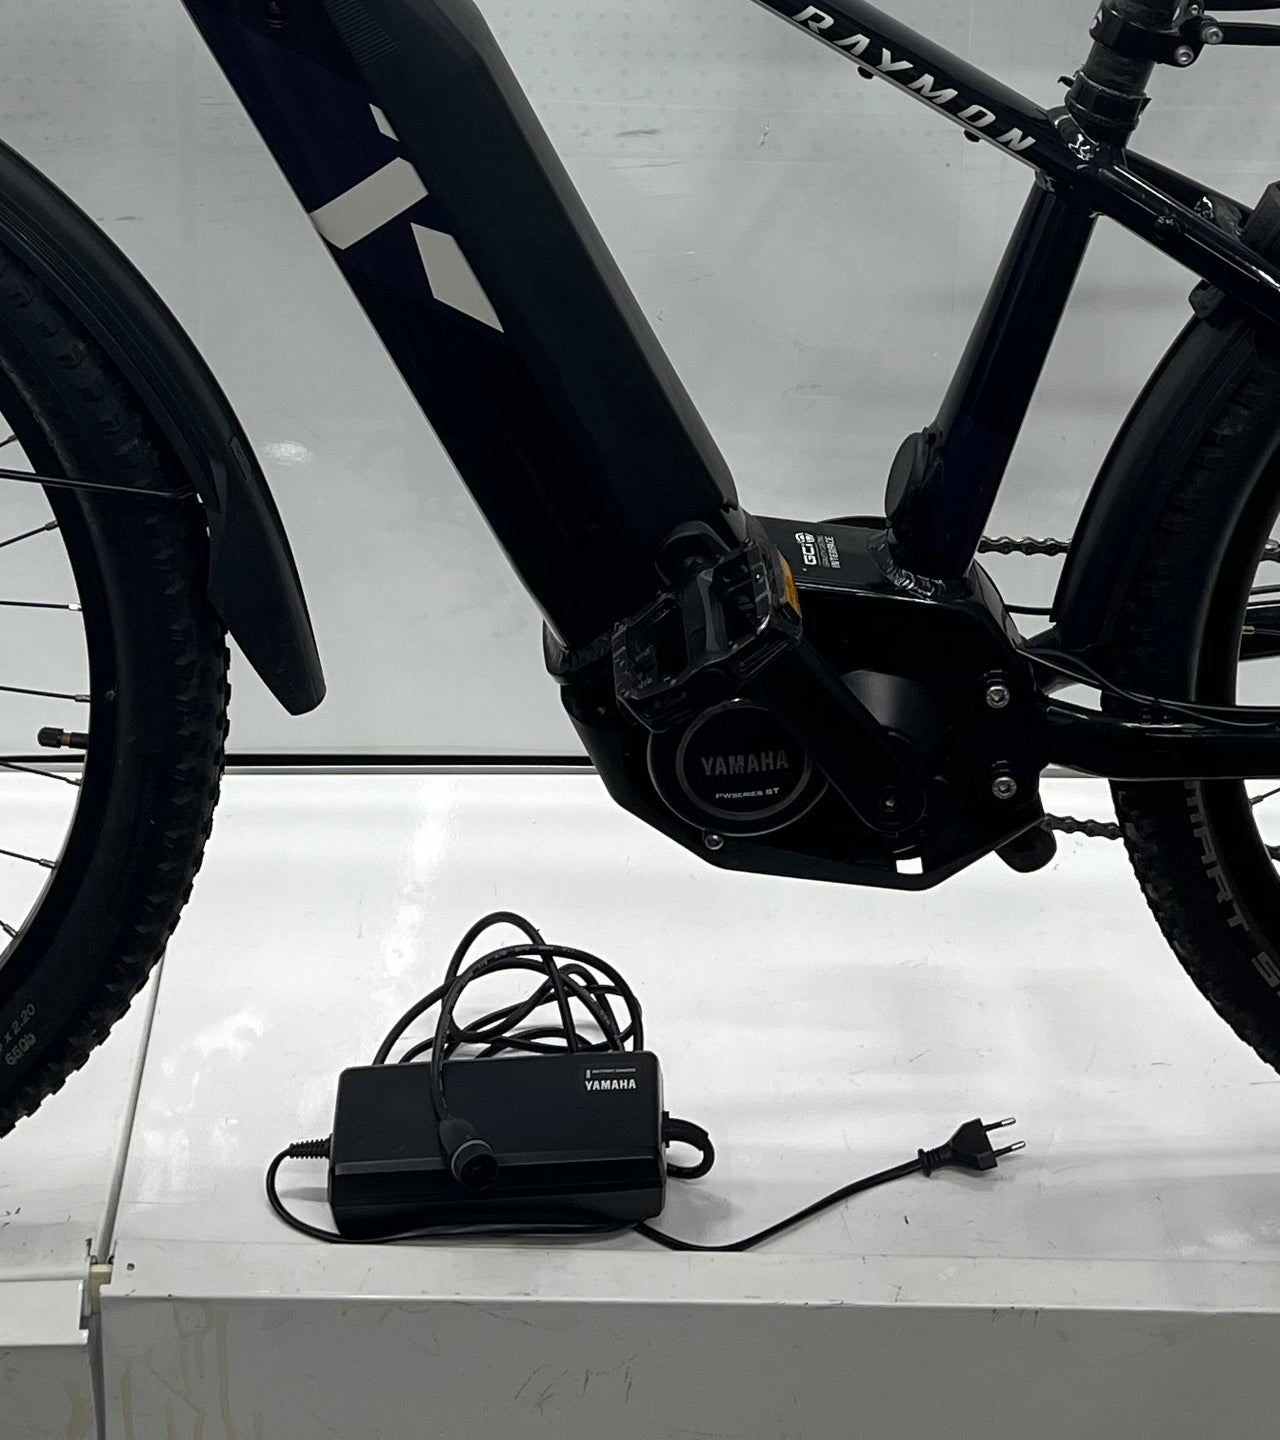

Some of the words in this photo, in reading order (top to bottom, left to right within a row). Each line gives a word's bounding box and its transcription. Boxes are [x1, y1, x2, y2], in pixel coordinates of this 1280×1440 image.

[790, 4, 1037, 152] RAYMON
[700, 749, 789, 776] YAMAHA
[1183, 779, 1250, 931] MART
[584, 1079, 637, 1091] YAMAHA
